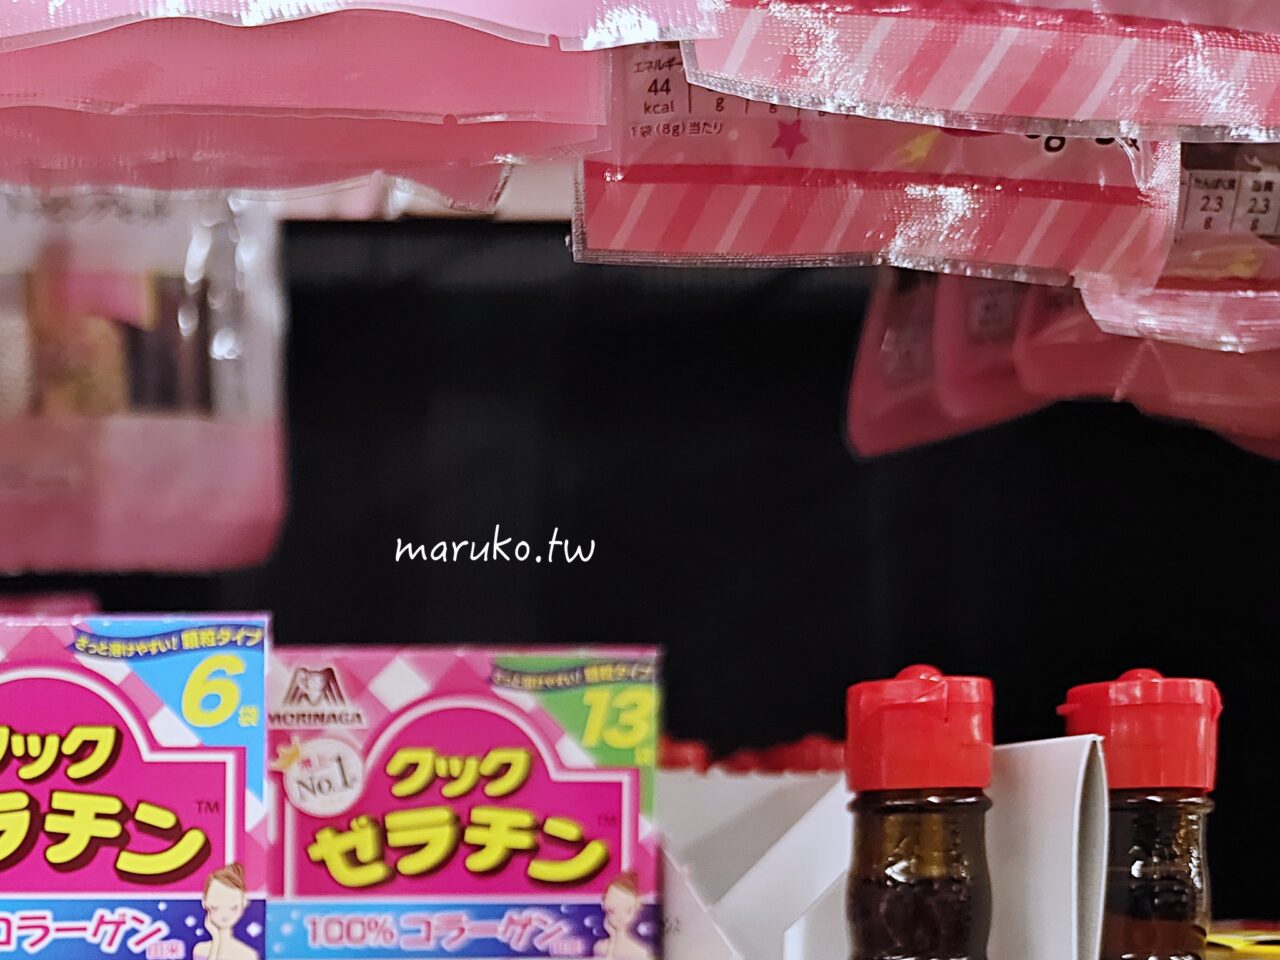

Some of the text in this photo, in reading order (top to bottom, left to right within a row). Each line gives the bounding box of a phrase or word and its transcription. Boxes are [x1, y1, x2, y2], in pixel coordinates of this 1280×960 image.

[648, 78, 671, 96] 44
[643, 102, 674, 115] kcal
[385, 746, 532, 798] クック
[307, 804, 611, 887] ゼラチン
